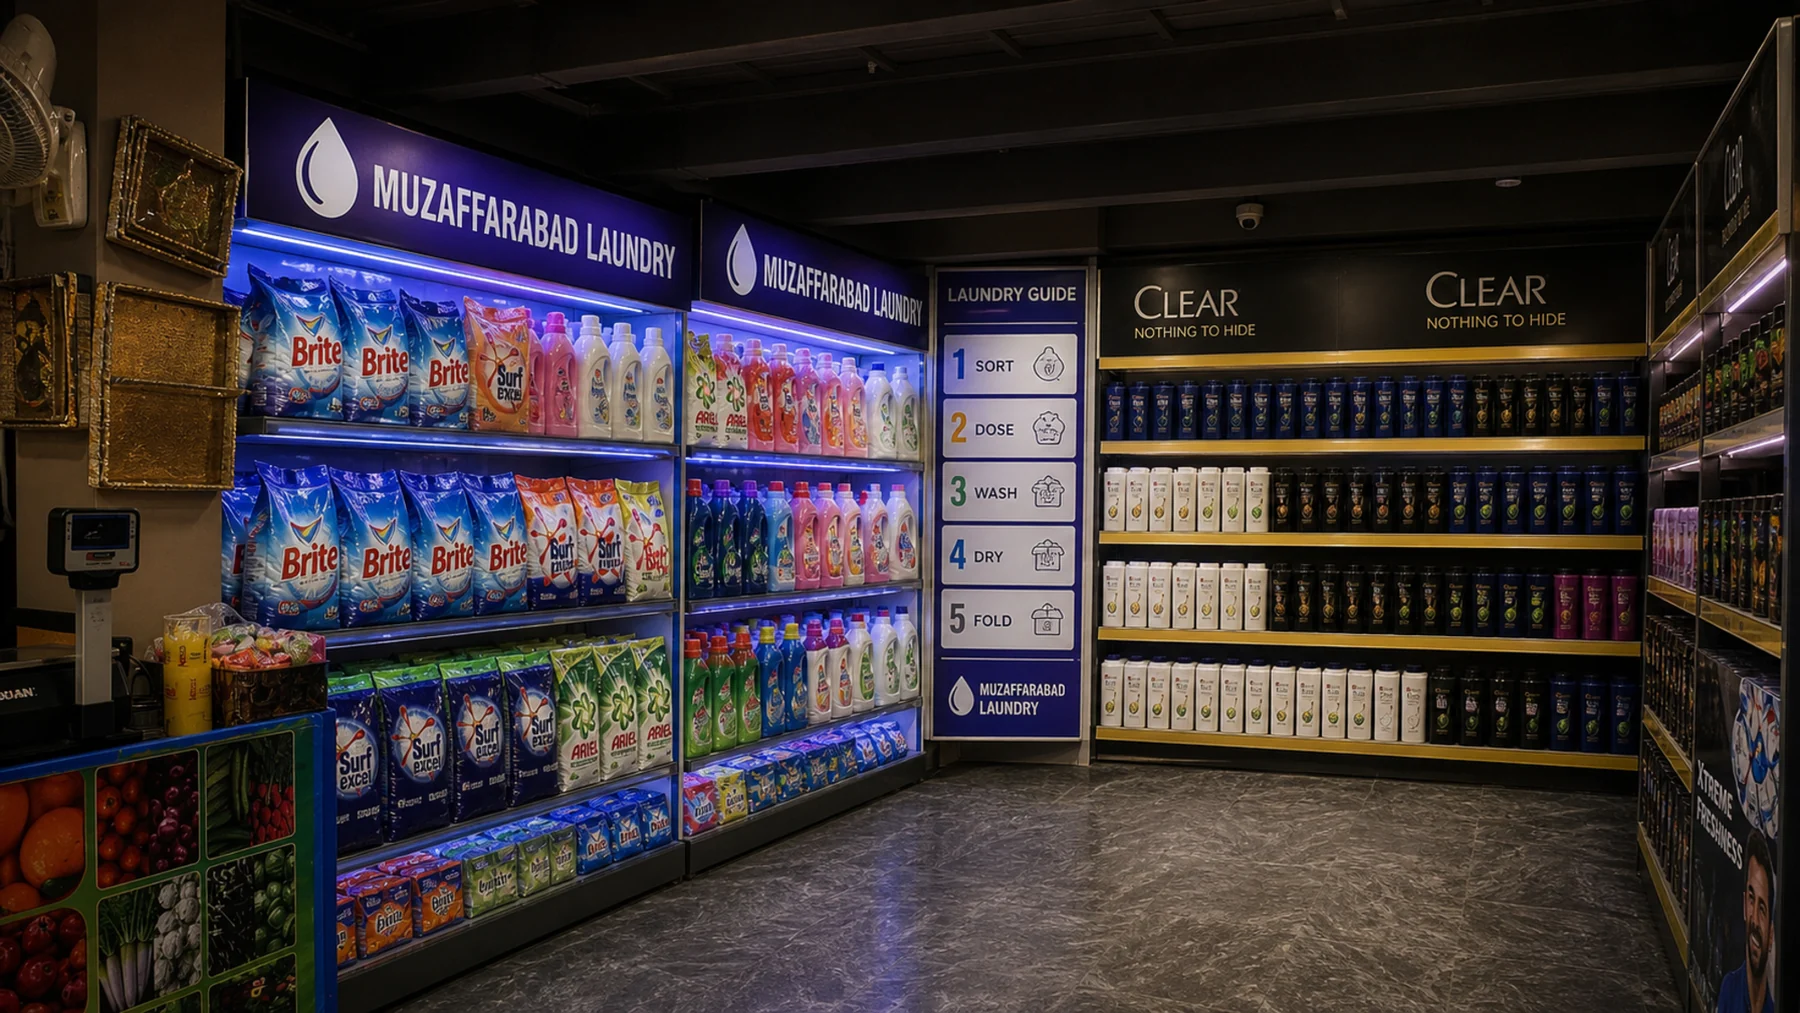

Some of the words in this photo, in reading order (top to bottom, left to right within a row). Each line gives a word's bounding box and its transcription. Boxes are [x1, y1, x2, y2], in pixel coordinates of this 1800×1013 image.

[373, 164, 579, 256] MUZAFFARABAD
[586, 223, 676, 279] LAUNDRY
[763, 254, 870, 313] MUZAFFARABAD
[874, 287, 923, 327] LAUNDRY
[948, 287, 1024, 302] LAUNDRY
[1028, 287, 1076, 301] GUIDE
[1134, 285, 1239, 319] CLEAR
[1426, 271, 1547, 308] CLEAR
[1134, 326, 1197, 339] NOTHING
[1201, 325, 1220, 337] TO
[1224, 324, 1256, 336] HIDE
[1427, 315, 1498, 330] NOTHING
[1503, 314, 1524, 327] TO
[1529, 313, 1566, 326] HIDE
[292, 335, 342, 367] Brite
[362, 347, 409, 376] Brite
[953, 348, 965, 379] 1
[976, 360, 1014, 372] SORT
[429, 359, 469, 388] Brite
[497, 363, 523, 388] Surf
[951, 412, 967, 443] 2
[975, 424, 1014, 436] DOSE
[950, 475, 966, 506] 3
[974, 487, 1017, 499] WASH
[281, 543, 338, 580] Brite
[363, 543, 411, 580] Brite
[431, 542, 473, 576] Brite
[489, 541, 527, 571] Brite
[950, 539, 966, 570] 4
[974, 551, 1003, 563] DRY
[949, 603, 965, 634] 5
[974, 615, 1012, 627] FOLD
[979, 683, 1065, 697] MUZAFFARABAD
[532, 711, 554, 735] Surf
[979, 701, 1039, 716] LAUNDRY
[412, 733, 442, 760] Surf
[475, 721, 499, 746] Surf
[340, 746, 373, 775] Surf
[413, 756, 441, 776] excel
[340, 769, 372, 790] excel
[1697, 759, 1733, 820] XTREME
[1696, 795, 1743, 870] FRESHNESS
